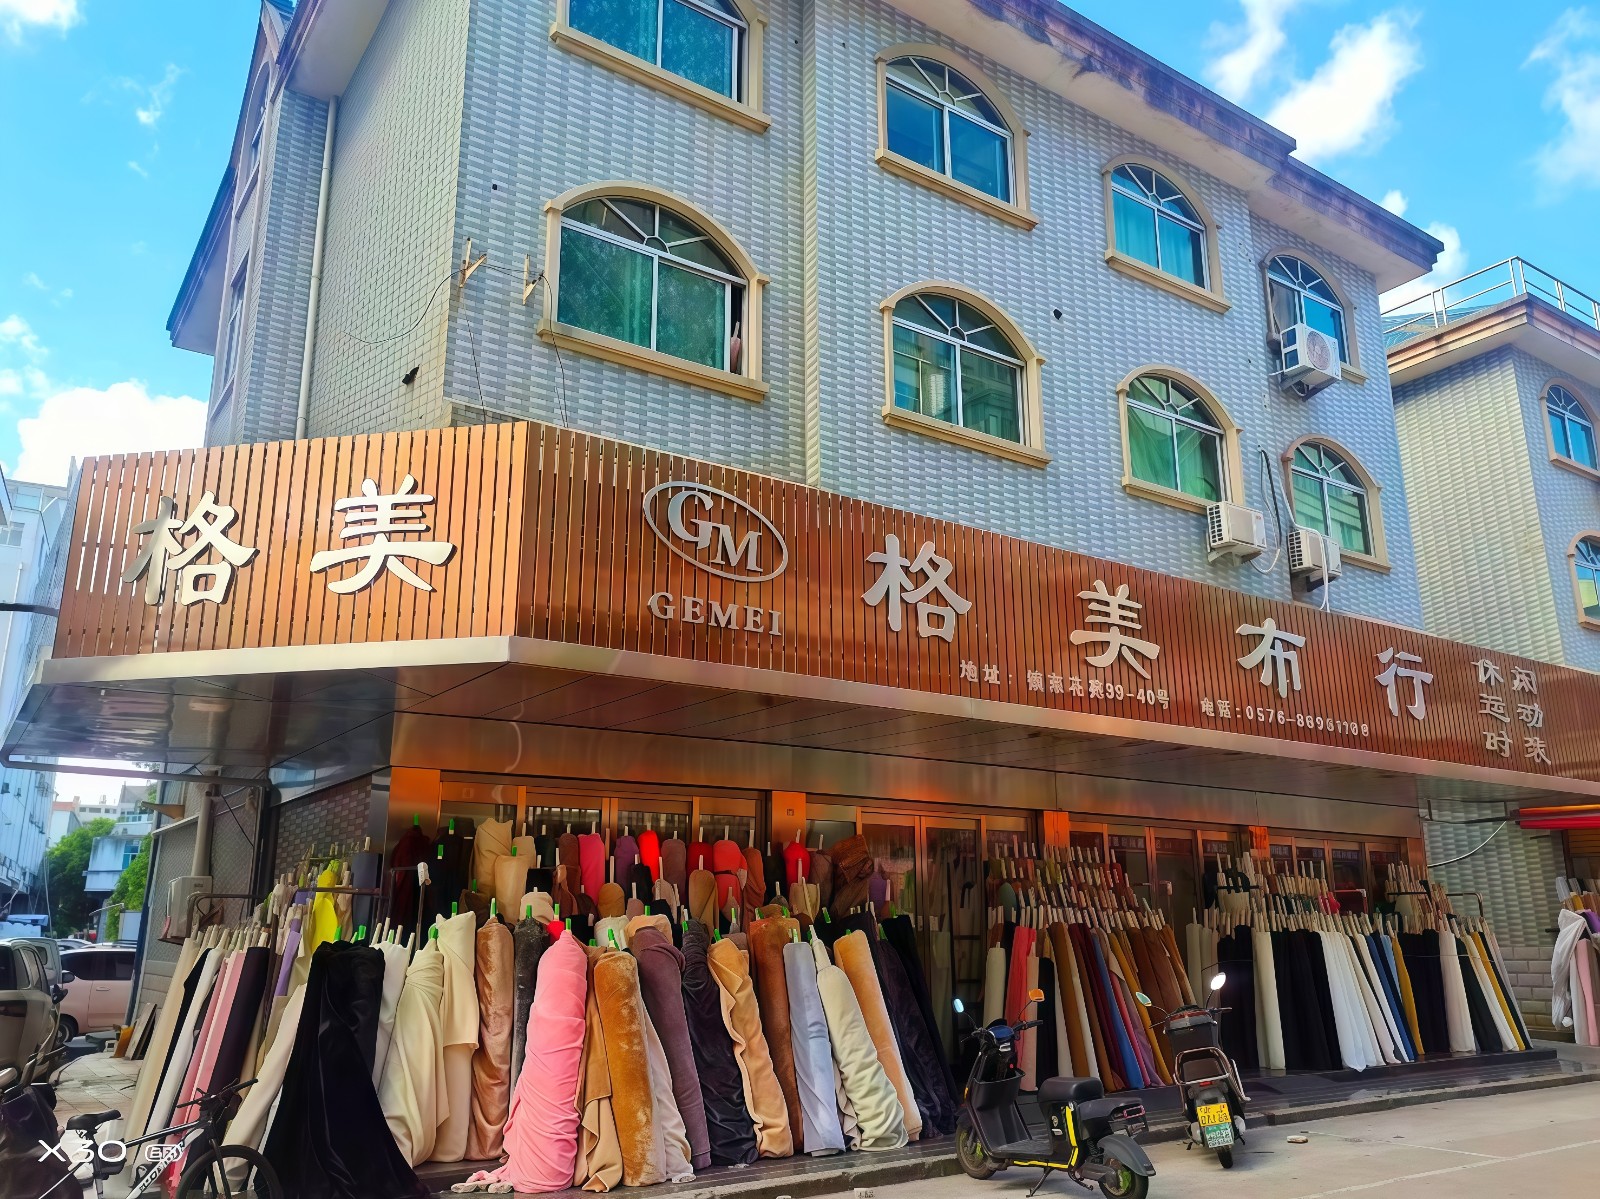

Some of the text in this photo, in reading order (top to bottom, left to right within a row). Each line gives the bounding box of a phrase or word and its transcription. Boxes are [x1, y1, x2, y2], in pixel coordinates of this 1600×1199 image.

[122, 474, 457, 606] 格美
[668, 490, 764, 573] GM
[647, 592, 783, 637] GEMEI
[861, 533, 1435, 720] 格美布行
[1471, 658, 1538, 695] 休闲
[1478, 693, 1544, 728] 运动
